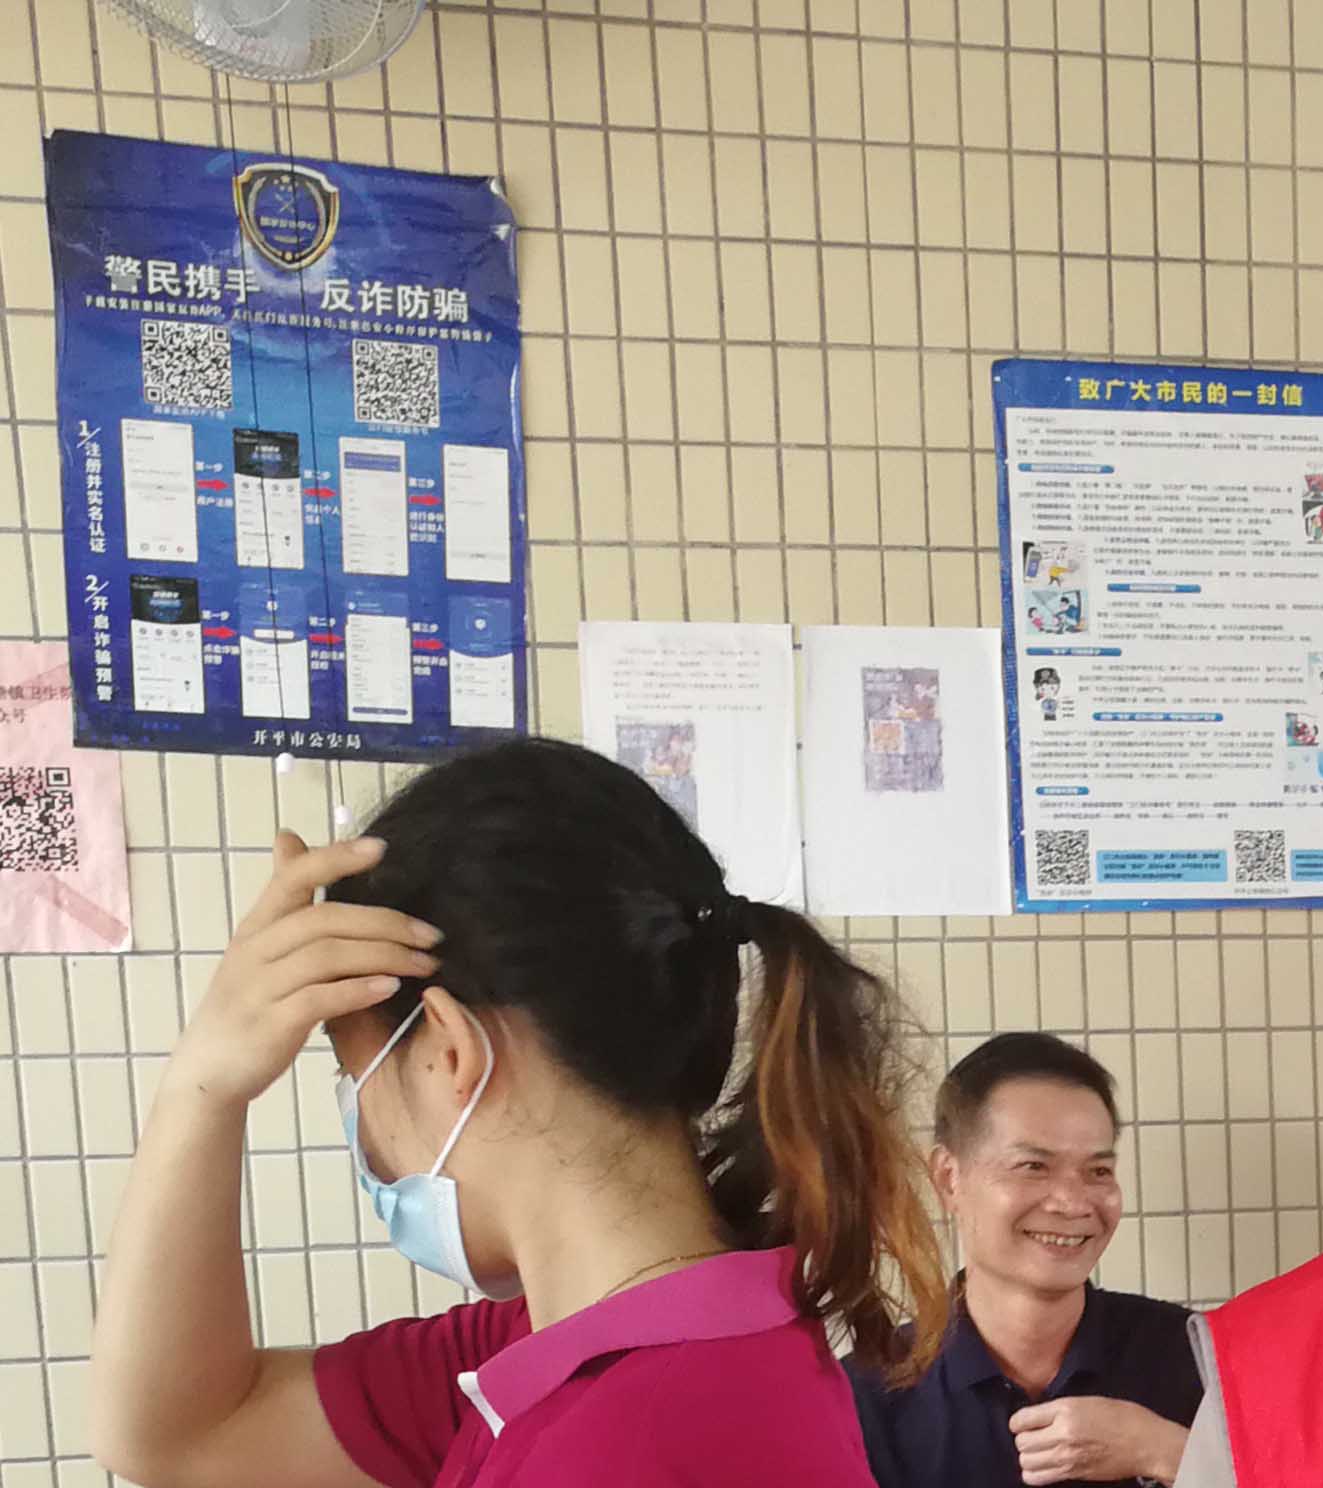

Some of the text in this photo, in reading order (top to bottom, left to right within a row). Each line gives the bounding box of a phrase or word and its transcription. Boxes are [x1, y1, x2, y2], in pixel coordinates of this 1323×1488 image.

[104, 253, 470, 323] 警民携手 反诈防骗
[1078, 377, 1304, 407] 致广大市民的一封信
